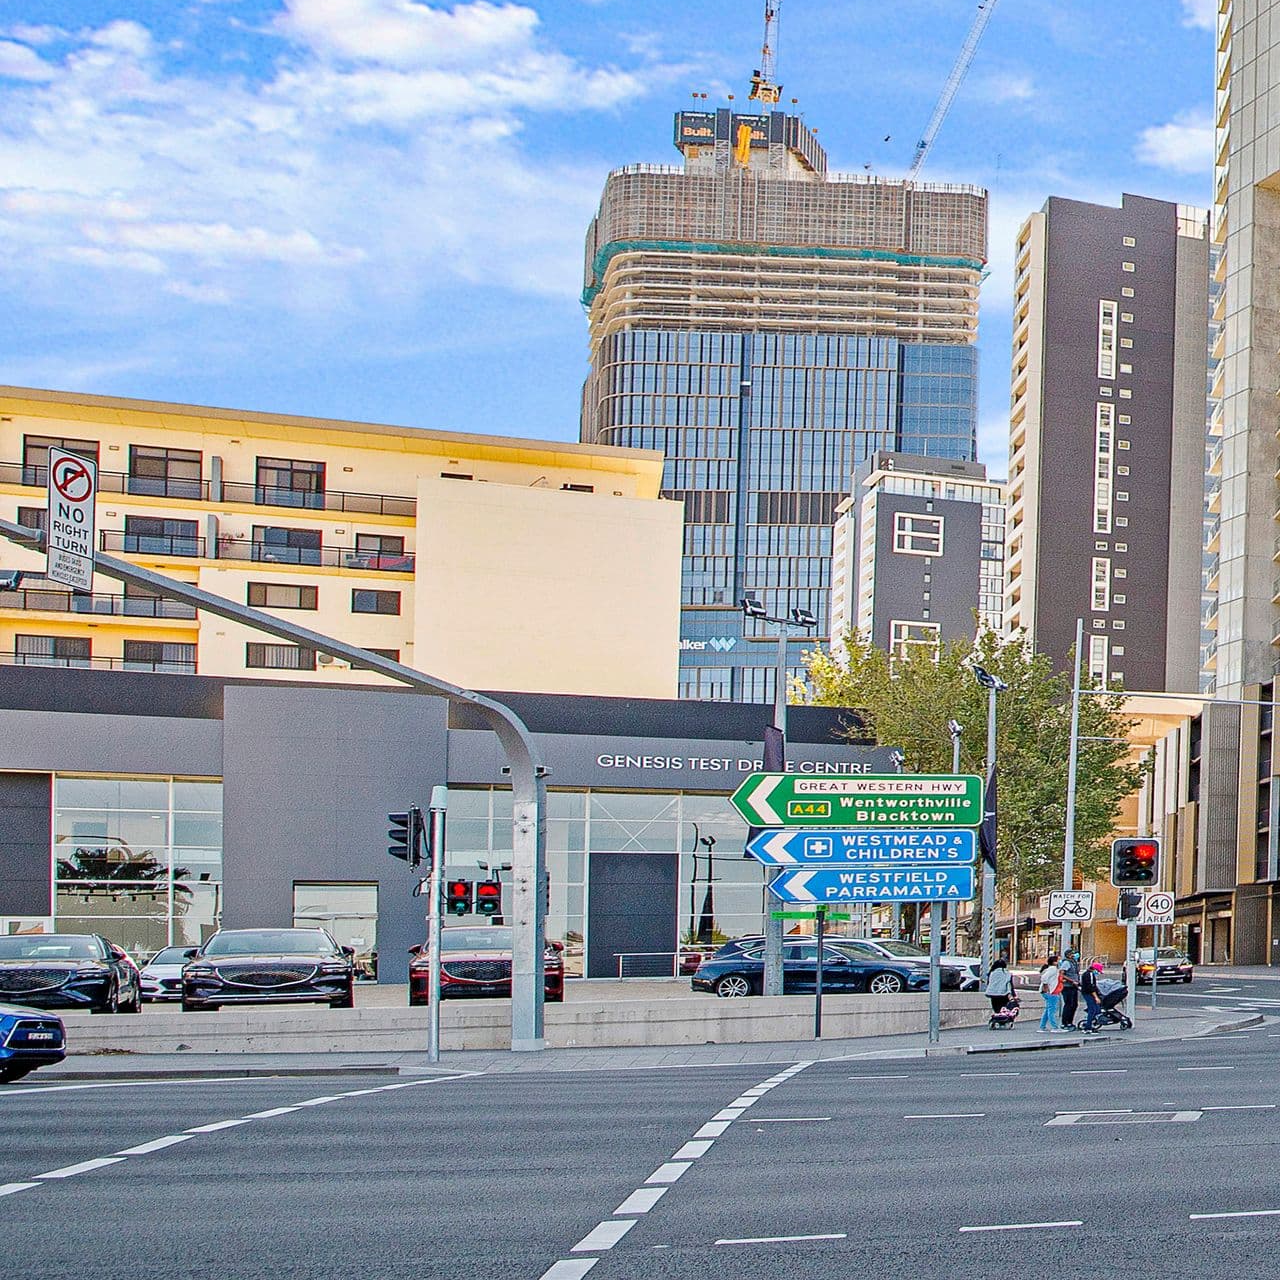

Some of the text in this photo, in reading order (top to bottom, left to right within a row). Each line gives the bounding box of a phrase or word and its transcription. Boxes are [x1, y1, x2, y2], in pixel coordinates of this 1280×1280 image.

[683, 127, 714, 137] Built.
[58, 502, 85, 524] NO
[53, 520, 89, 540] RIGHT
[55, 536, 88, 555] TURN
[597, 754, 683, 770] GENESIS
[688, 757, 732, 771] TEST
[737, 758, 794, 773] DRE
[799, 782, 963, 791] GREAT WESTERN HWY
[839, 797, 972, 808] Wentworthville
[792, 804, 826, 814] A44
[856, 811, 955, 822] Blacktown
[841, 835, 963, 846] WESTMEAD &
[846, 848, 959, 859] CHILDREN'S
[839, 872, 948, 884] WESTFIELD
[826, 884, 960, 898] PARRAMATTA
[1149, 898, 1170, 910] 40
[1146, 915, 1172, 923] AREA
